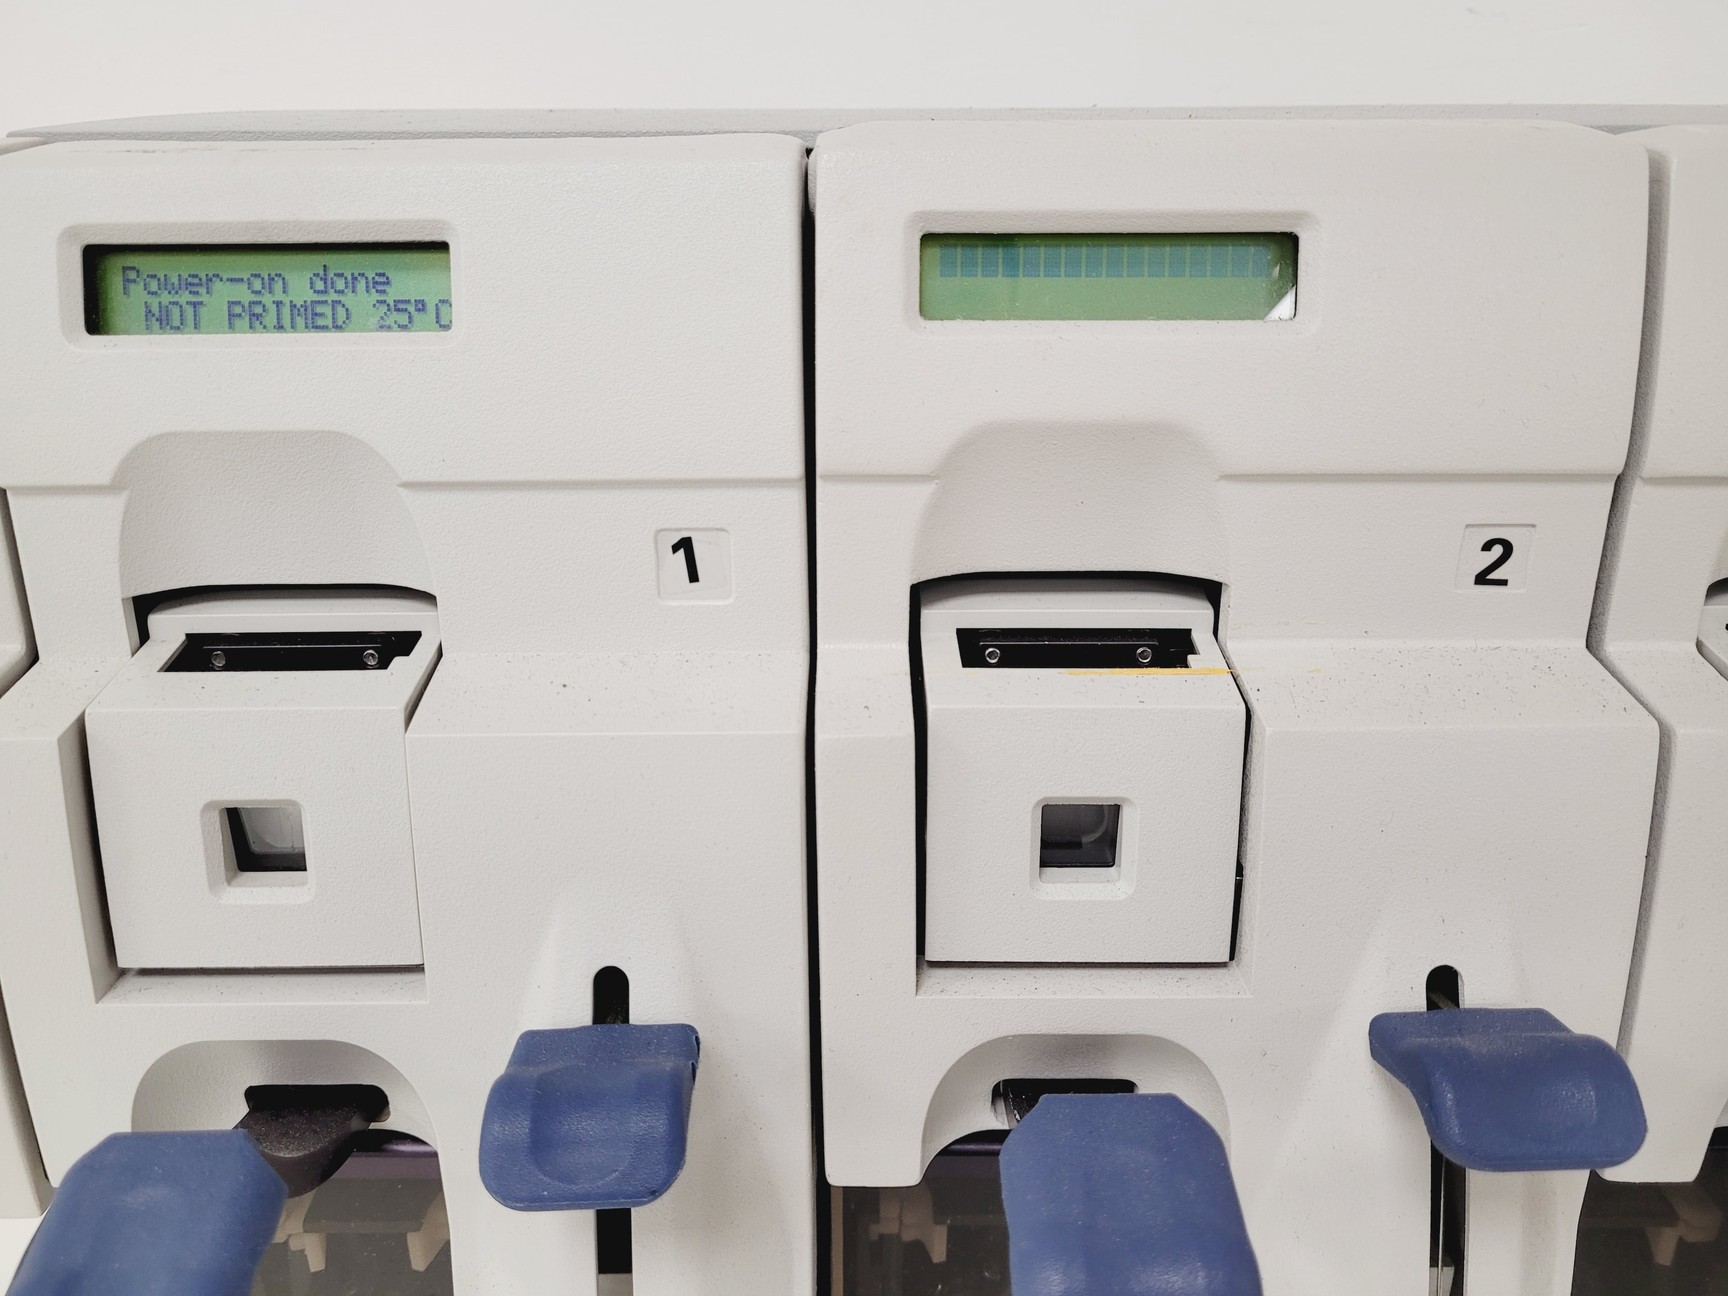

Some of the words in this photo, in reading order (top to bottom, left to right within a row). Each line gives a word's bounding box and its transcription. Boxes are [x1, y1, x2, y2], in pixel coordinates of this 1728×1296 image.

[121, 265, 288, 296] Power-on
[309, 264, 392, 295] done
[144, 300, 204, 331] NOT
[227, 299, 351, 330] PRIMED
[671, 536, 700, 584] 1
[1474, 537, 1514, 586] 2
